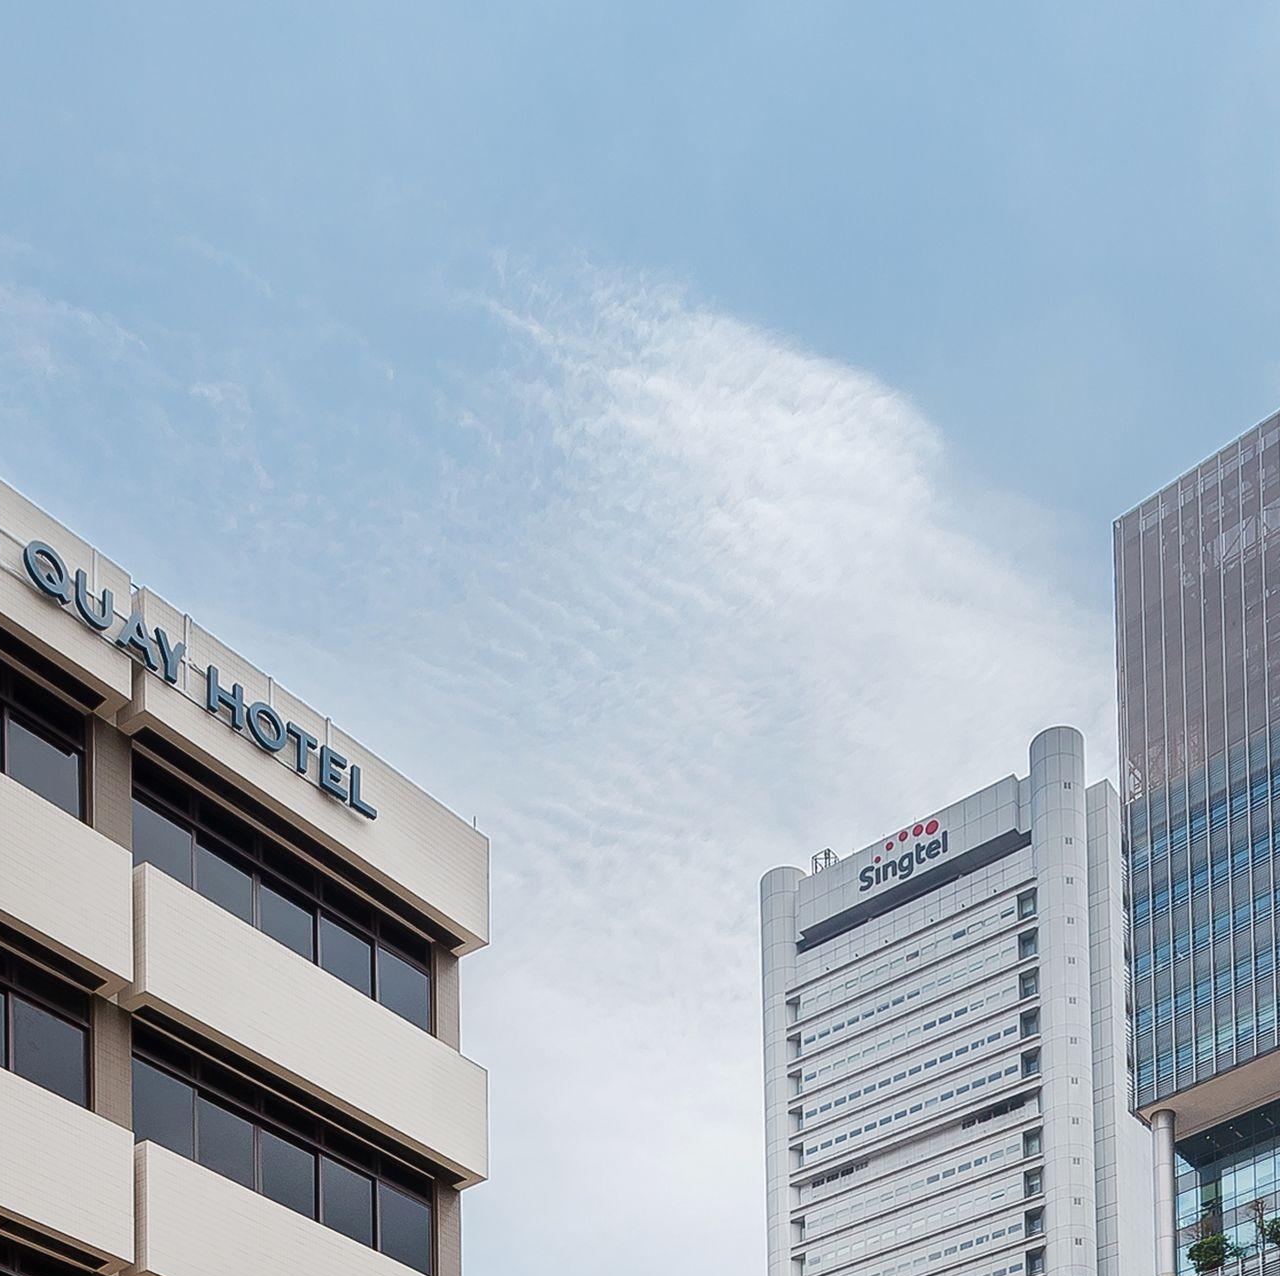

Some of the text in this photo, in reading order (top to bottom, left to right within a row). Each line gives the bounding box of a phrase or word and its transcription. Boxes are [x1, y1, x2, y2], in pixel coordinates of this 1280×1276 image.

[22, 540, 186, 684] QUAY
[206, 664, 378, 821] HOTEL
[859, 830, 948, 891] Singtel
